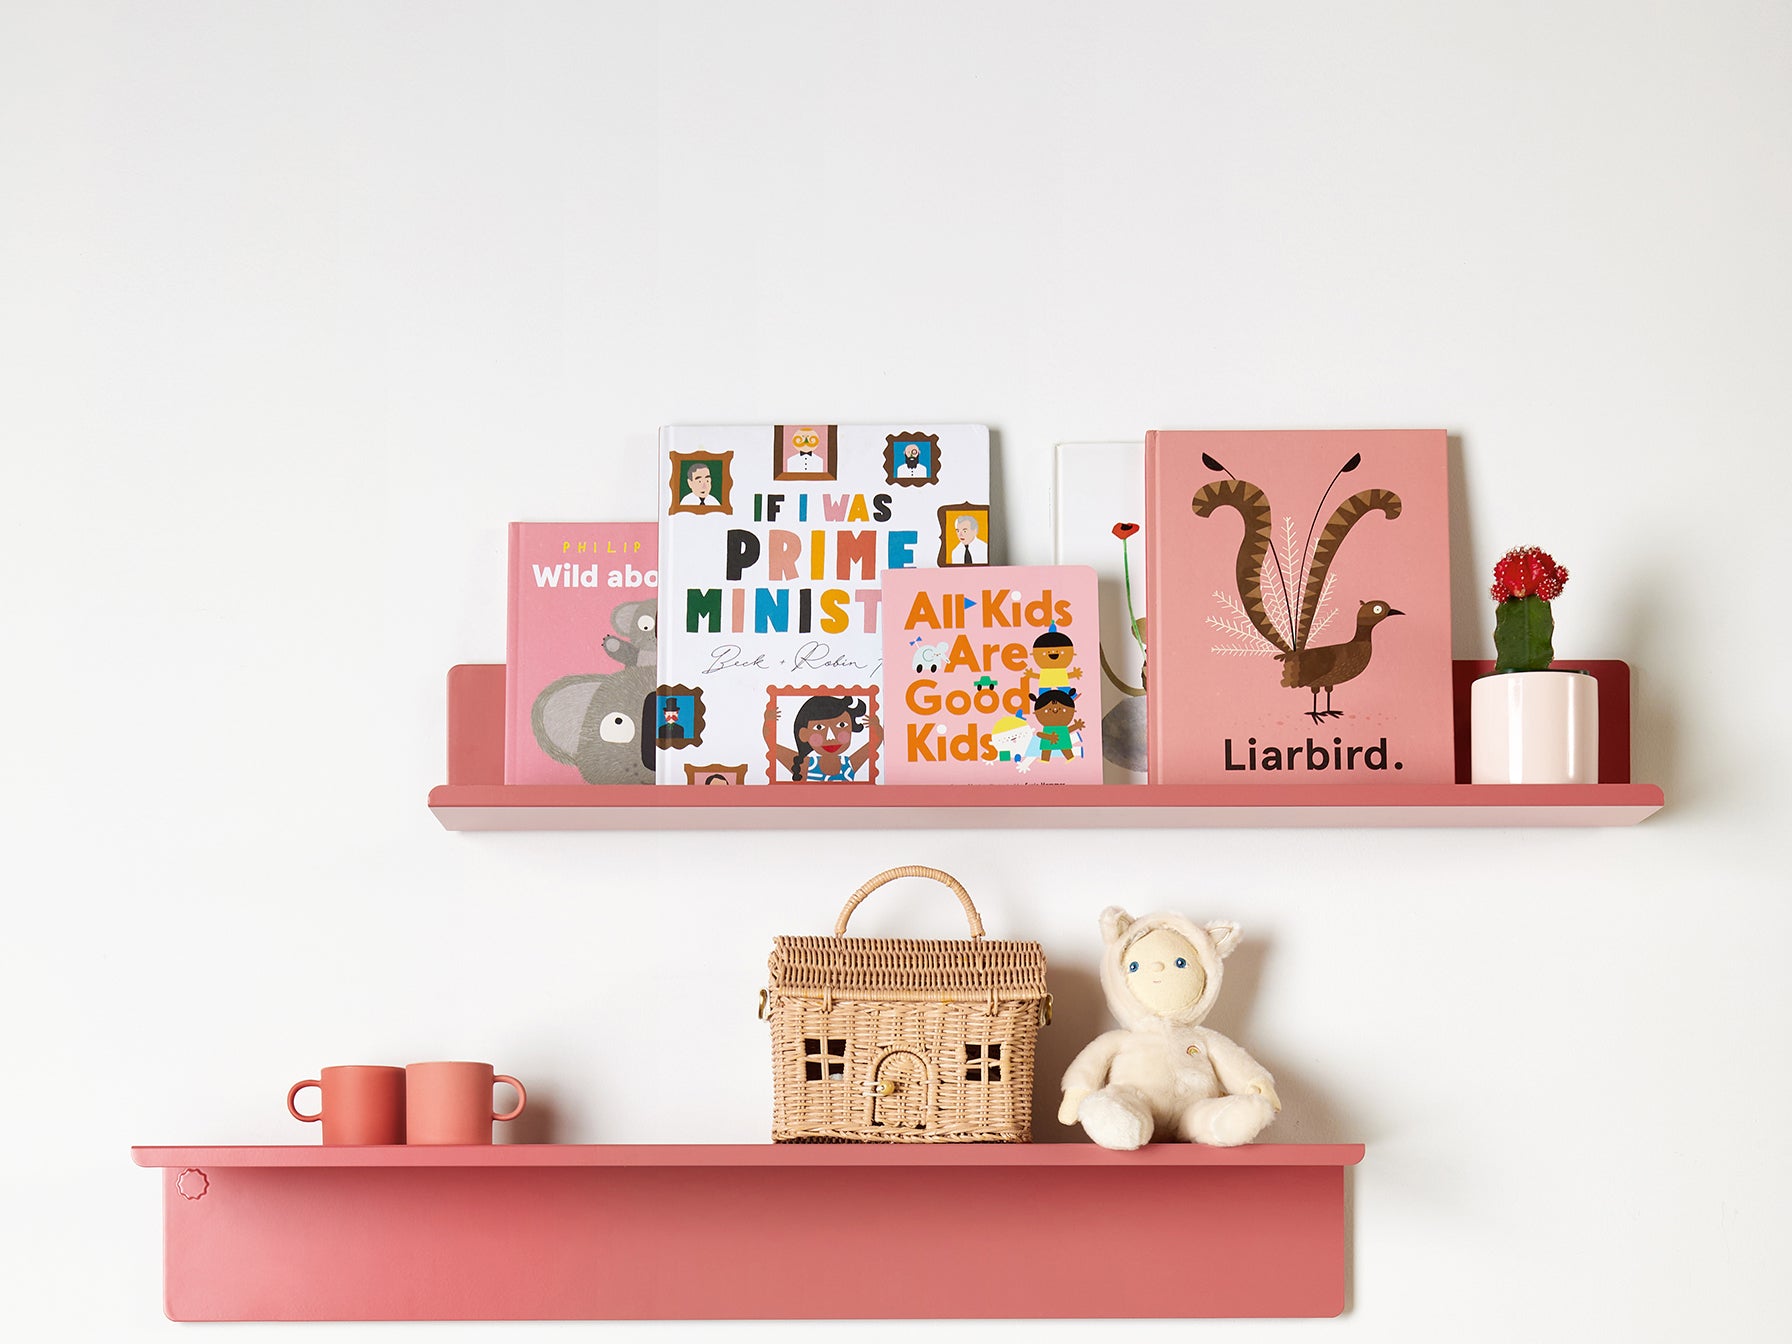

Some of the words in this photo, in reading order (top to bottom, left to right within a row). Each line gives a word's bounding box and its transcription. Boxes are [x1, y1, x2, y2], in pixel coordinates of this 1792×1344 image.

[753, 493, 785, 522] IF
[799, 493, 808, 522] I
[822, 493, 893, 522] WAS
[562, 541, 641, 553] PHILIP
[726, 529, 917, 581] PRIME
[532, 562, 599, 588] Wild
[904, 591, 965, 630] All
[982, 589, 1073, 628] Kids
[702, 644, 769, 674] Beck
[791, 640, 868, 673] Robin
[944, 634, 1028, 673] Are
[905, 676, 1030, 717] Good
[907, 723, 998, 763] Kids
[1224, 737, 1404, 771] Liarbird.
